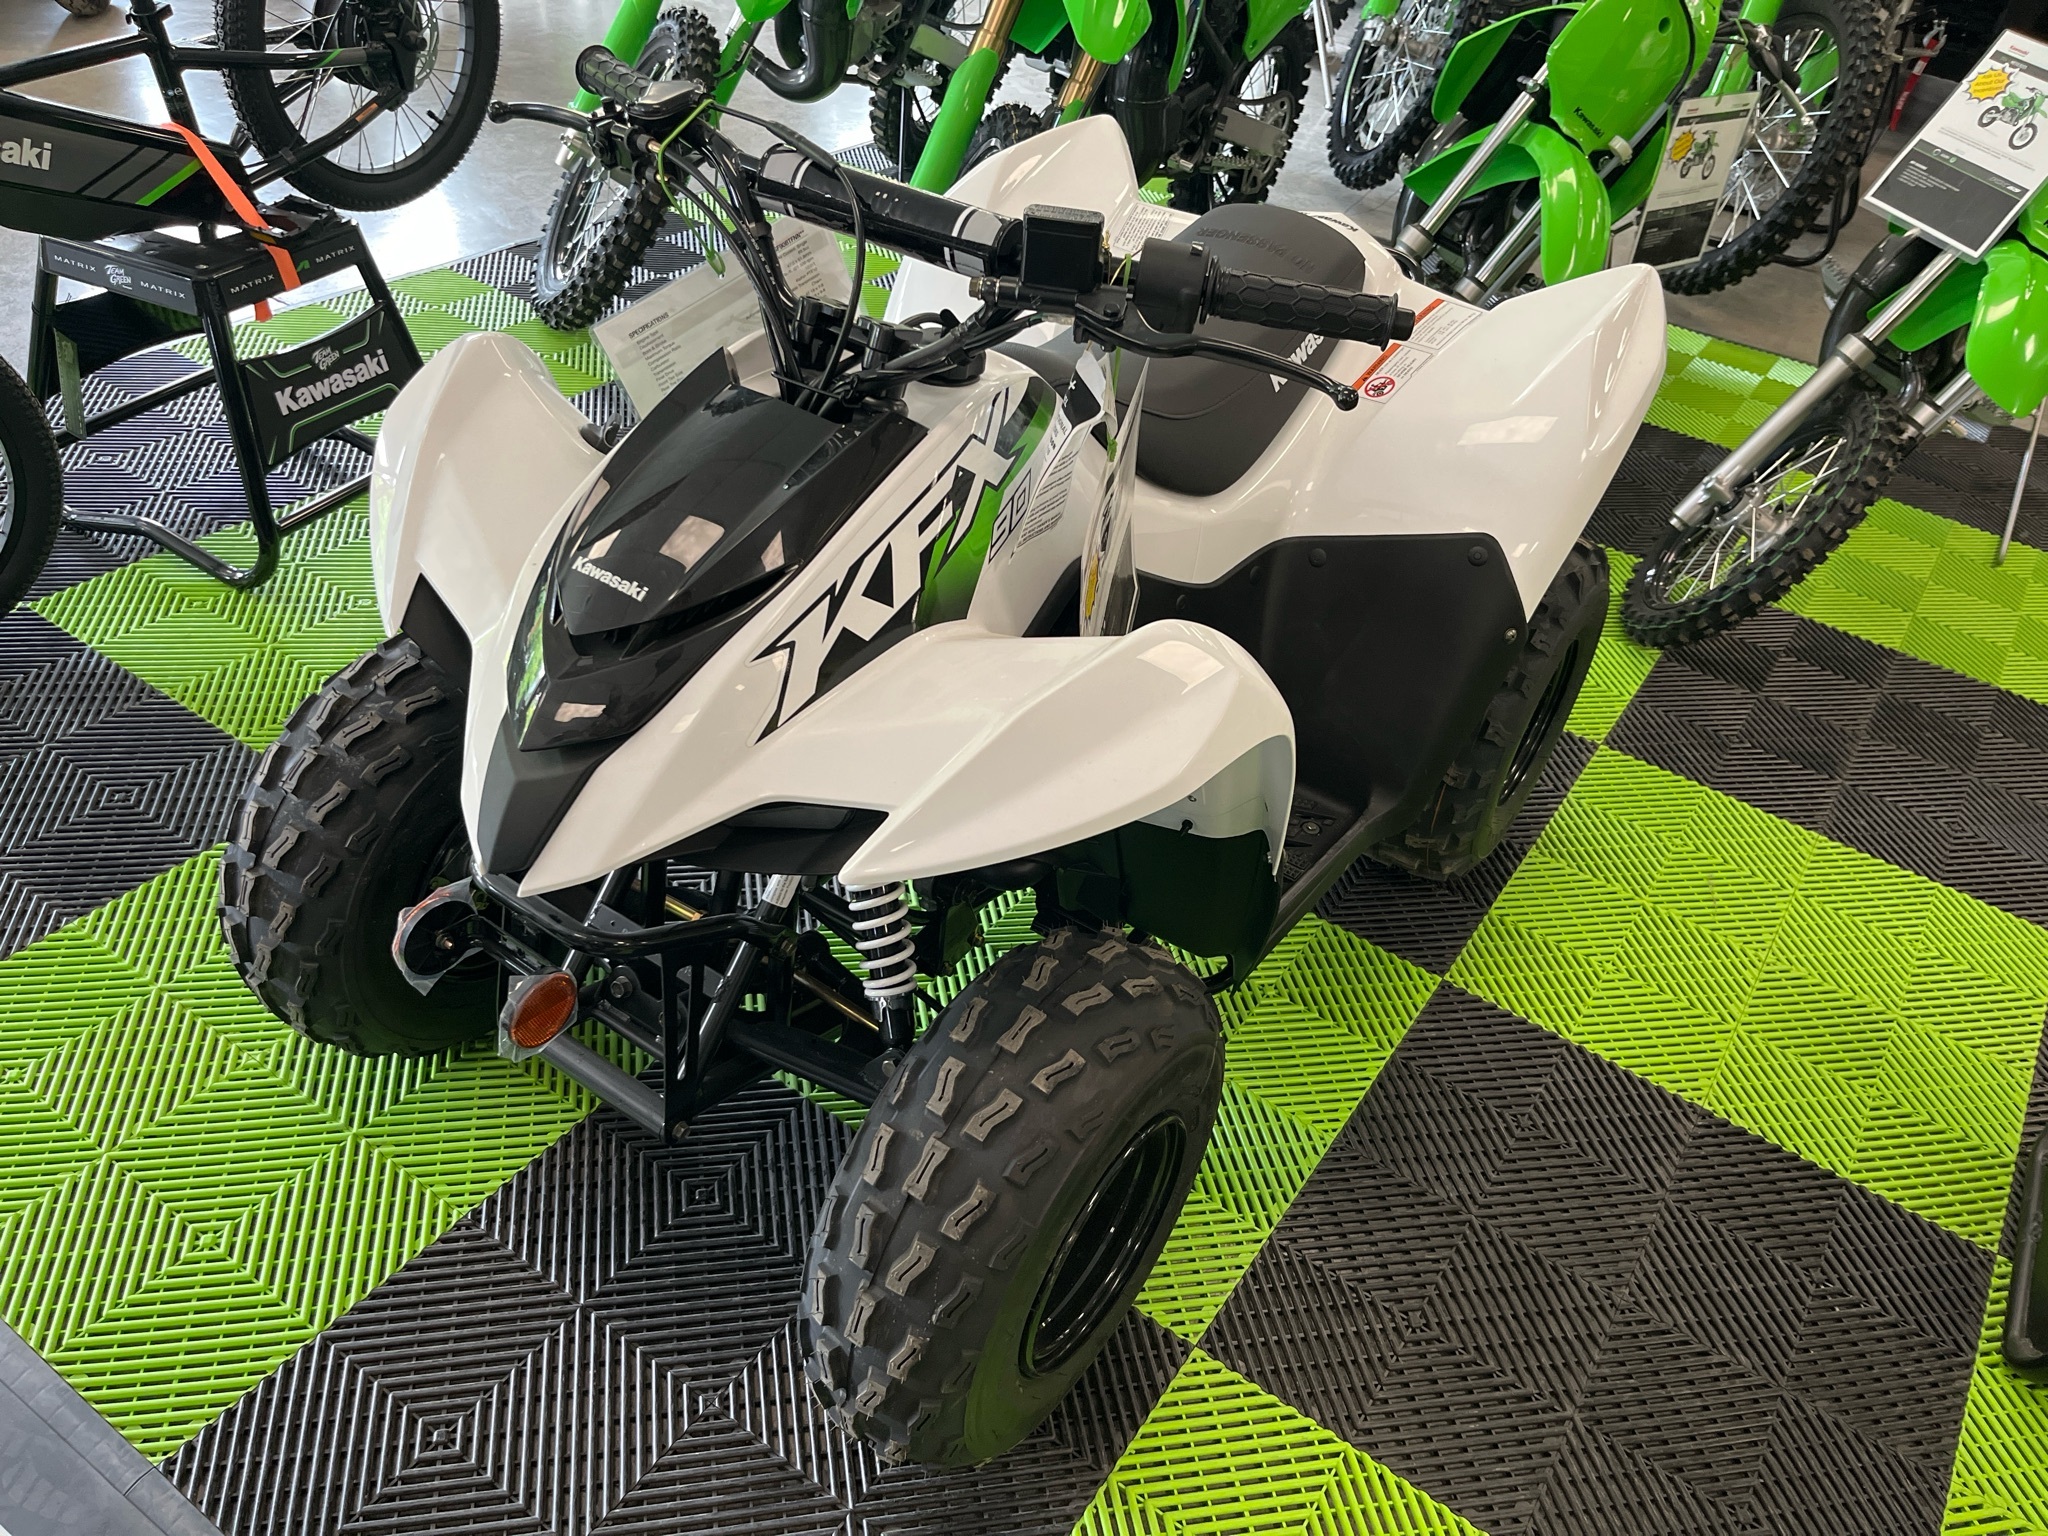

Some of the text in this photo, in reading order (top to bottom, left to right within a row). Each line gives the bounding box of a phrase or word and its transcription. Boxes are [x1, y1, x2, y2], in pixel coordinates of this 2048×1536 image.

[1573, 106, 1605, 138] Kawasaki
[0, 137, 52, 171] aki
[54, 255, 97, 272] MATRIX
[315, 245, 356, 264] MATRIX
[104, 264, 125, 277] TEAM
[109, 274, 132, 286] GREEN
[140, 281, 186, 299] MATRIX
[230, 273, 275, 294] MATRIX
[628, 312, 669, 338] SPECIFICATIONS
[311, 346, 333, 363] TEAM
[319, 351, 340, 370] GREEN
[273, 349, 390, 416] Kawasaki
[989, 468, 1031, 564] 90
[751, 386, 1027, 745] KFX
[571, 556, 650, 602] Kawasaki
